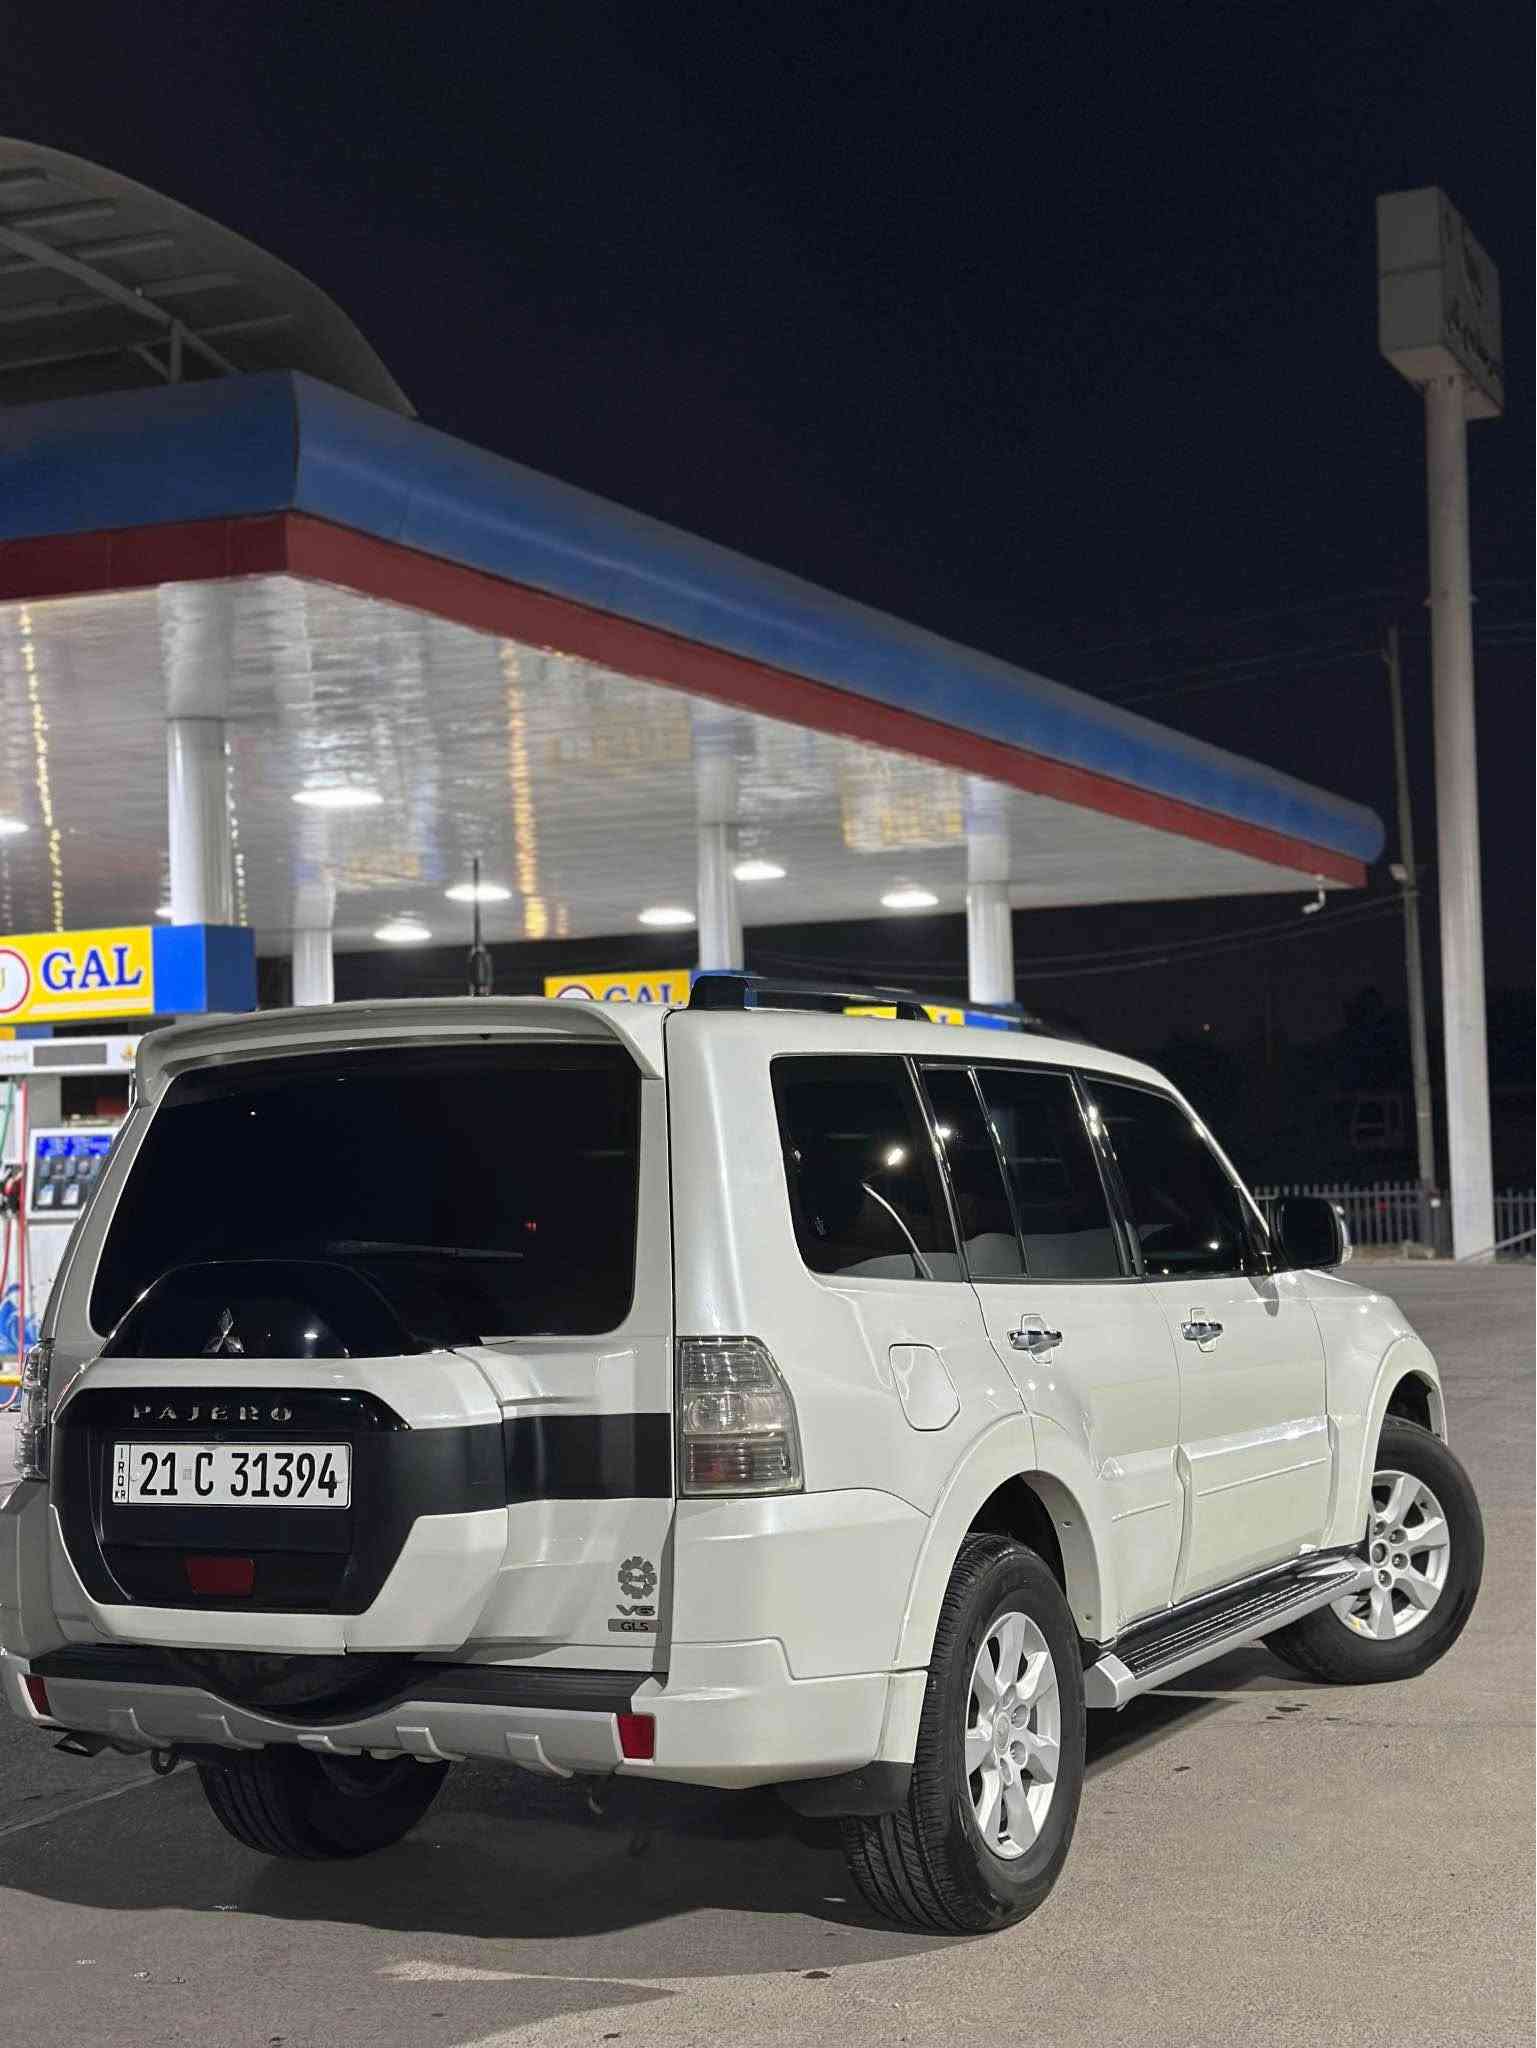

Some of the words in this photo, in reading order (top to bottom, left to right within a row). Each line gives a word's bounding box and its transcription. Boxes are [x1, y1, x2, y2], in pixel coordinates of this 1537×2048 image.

[42, 946, 142, 990] GAL
[132, 1405, 293, 1422] PAJERO
[140, 1451, 178, 1496] 21
[194, 1452, 214, 1497] C
[230, 1452, 338, 1499] 31394
[616, 1604, 656, 1616] V6
[620, 1621, 649, 1631] GLS
